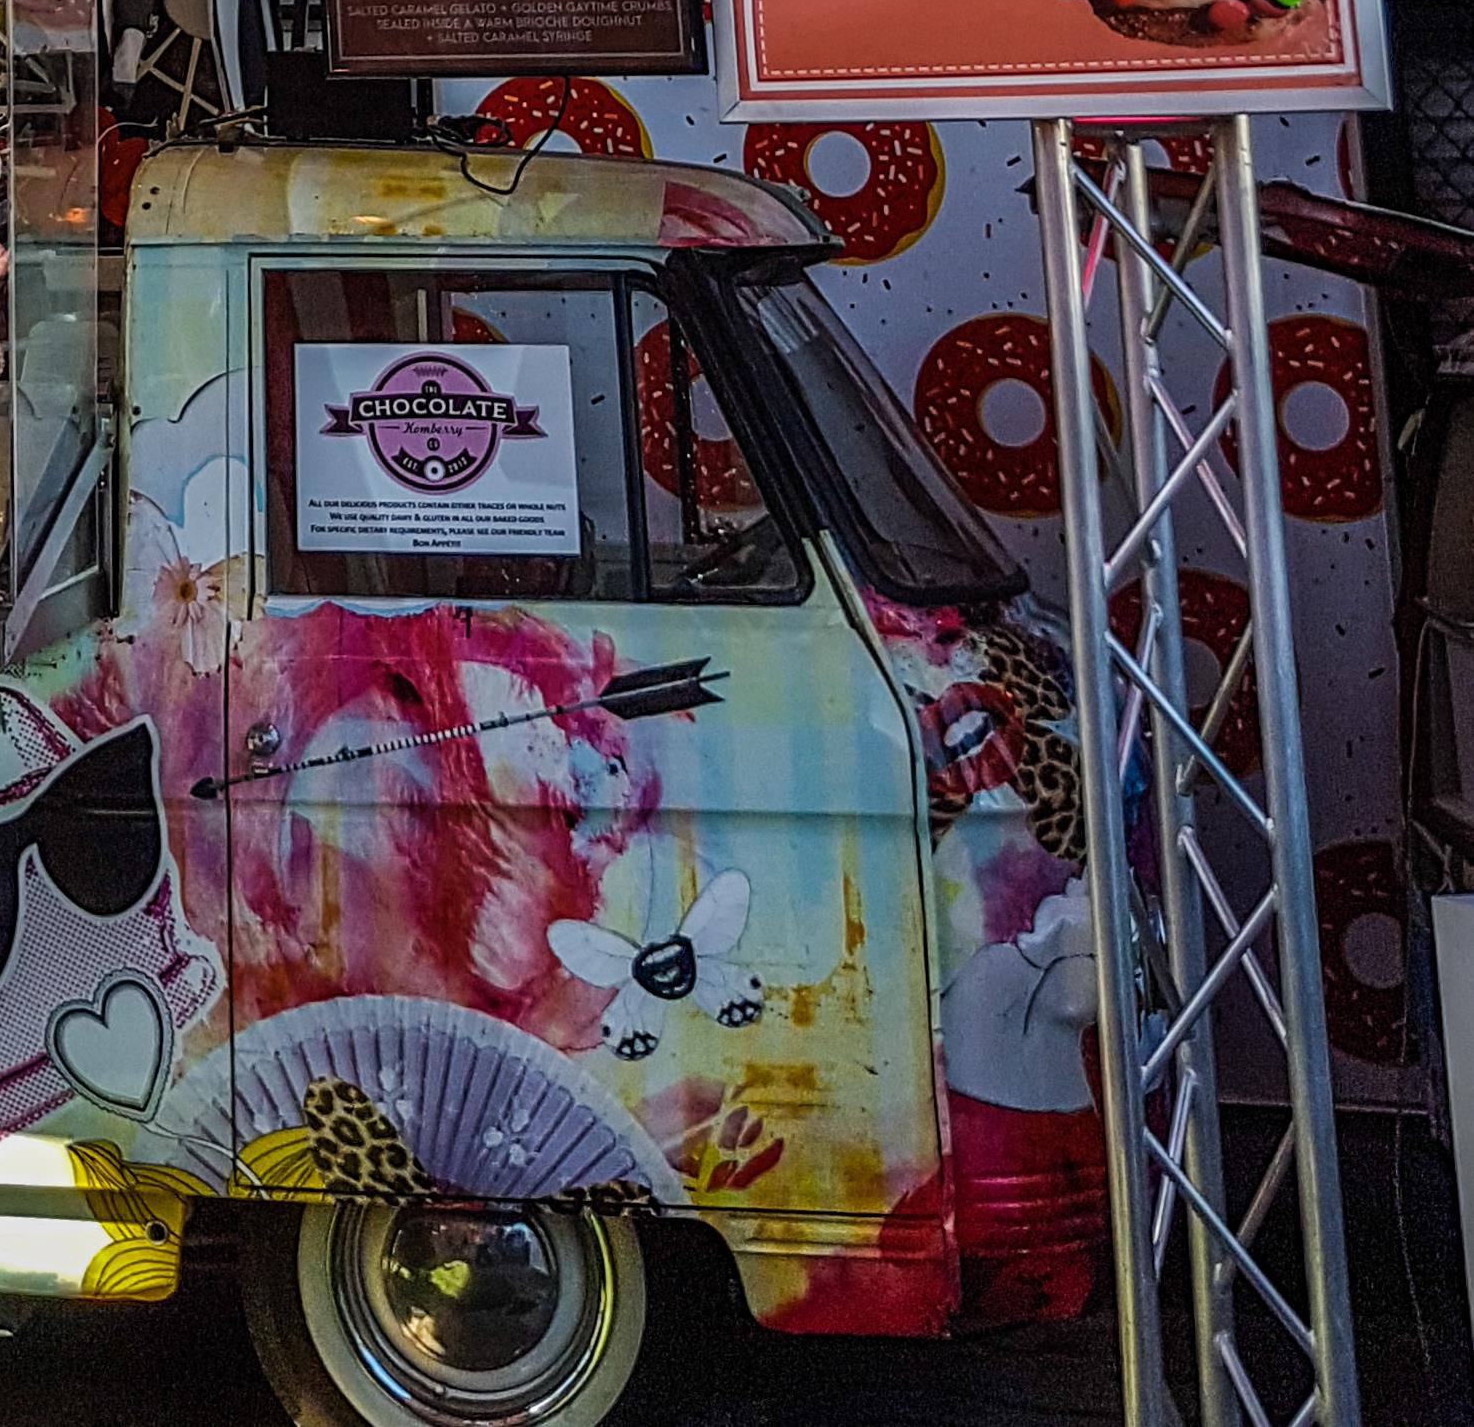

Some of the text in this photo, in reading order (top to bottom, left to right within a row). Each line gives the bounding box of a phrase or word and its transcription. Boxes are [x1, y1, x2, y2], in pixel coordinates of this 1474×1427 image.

[347, 5, 389, 16] SALTED
[391, 4, 447, 15] CARAMEL
[449, 3, 496, 14] GELATO
[511, 1, 562, 13] GOLDEN
[565, 1, 618, 12] GAYTIME
[377, 19, 420, 30] SEALED
[463, 19, 474, 28] A
[515, 16, 569, 28] BRIOCHE
[572, 15, 642, 27] DOUGHNUT
[437, 32, 480, 43] SALTED
[482, 31, 539, 42] CARAMEL
[358, 398, 507, 419] CHOCOLATE
